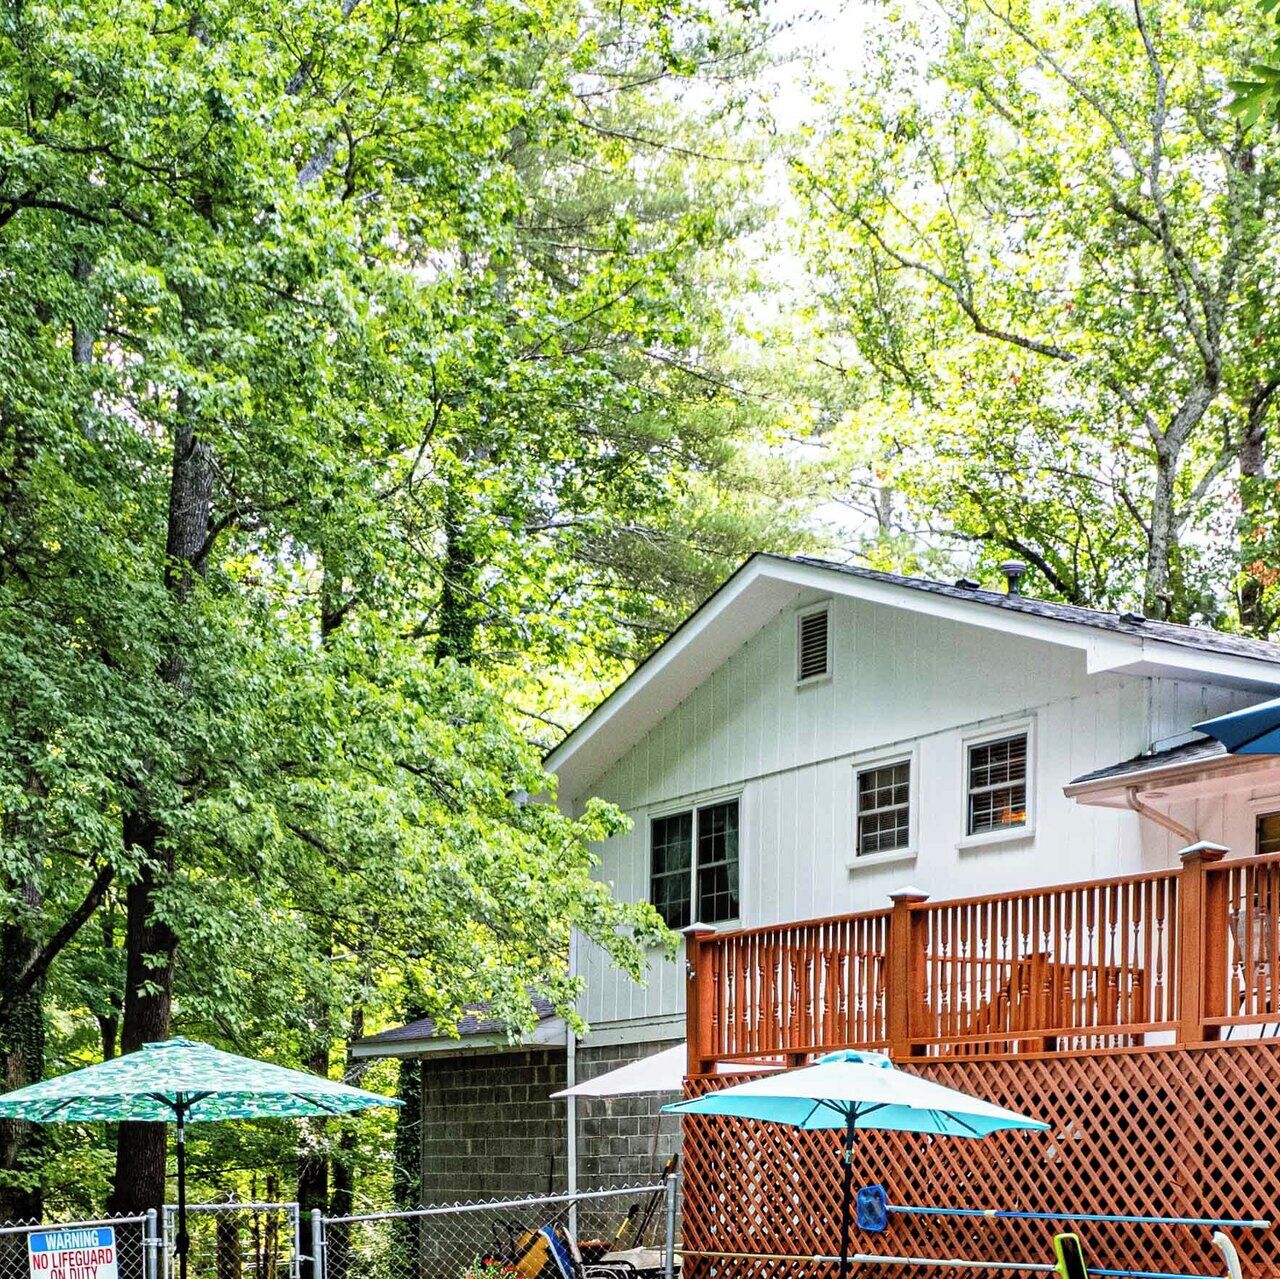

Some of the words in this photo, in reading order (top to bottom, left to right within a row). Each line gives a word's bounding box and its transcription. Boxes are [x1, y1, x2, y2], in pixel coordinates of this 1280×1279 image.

[46, 1230, 99, 1250] WARNING
[33, 1253, 48, 1270] NO
[52, 1249, 113, 1268] LIFEGUARD
